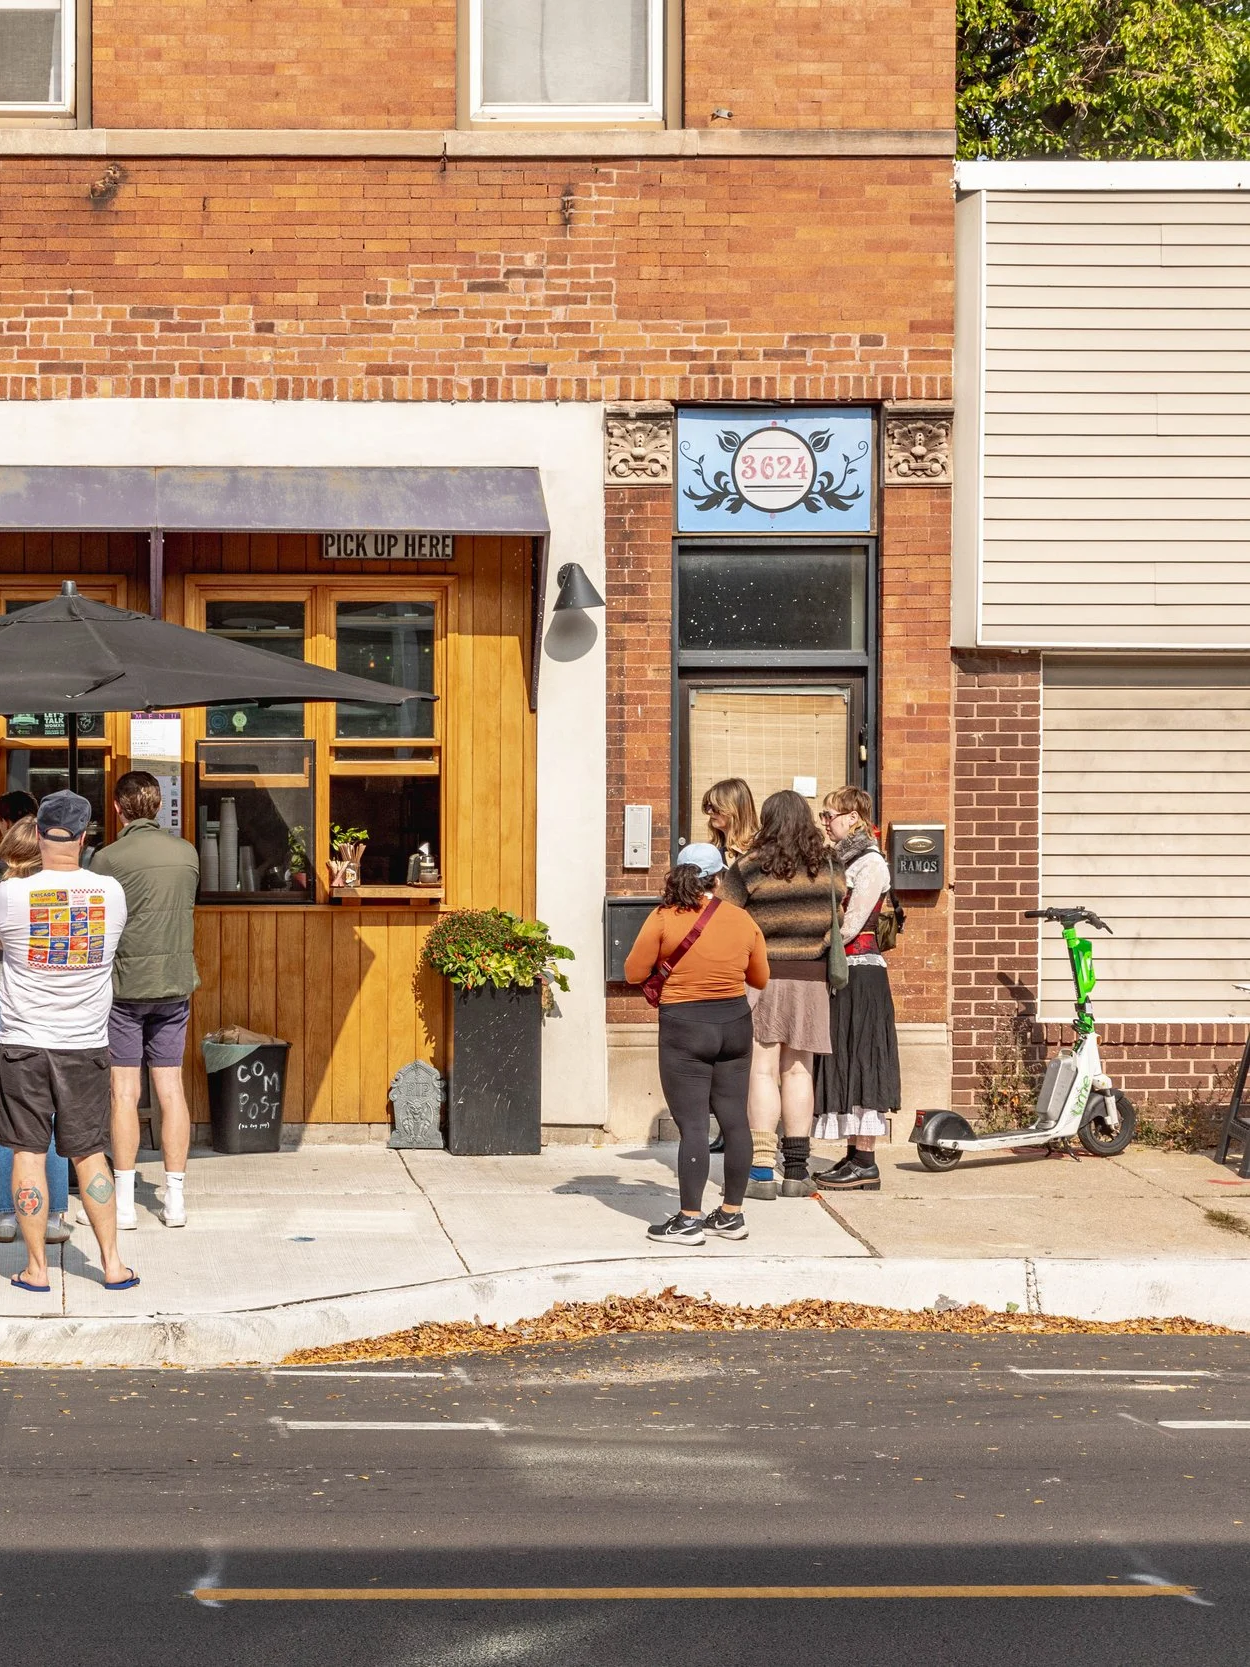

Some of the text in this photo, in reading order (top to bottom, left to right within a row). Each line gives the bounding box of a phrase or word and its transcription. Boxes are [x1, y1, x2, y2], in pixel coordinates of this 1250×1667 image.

[741, 455, 808, 480] 3624
[324, 533, 450, 558] PICK UP HERE
[900, 860, 938, 872] RAMOS
[237, 1061, 280, 1092] COM
[405, 1082, 429, 1097] RIP
[238, 1092, 279, 1120] POST
